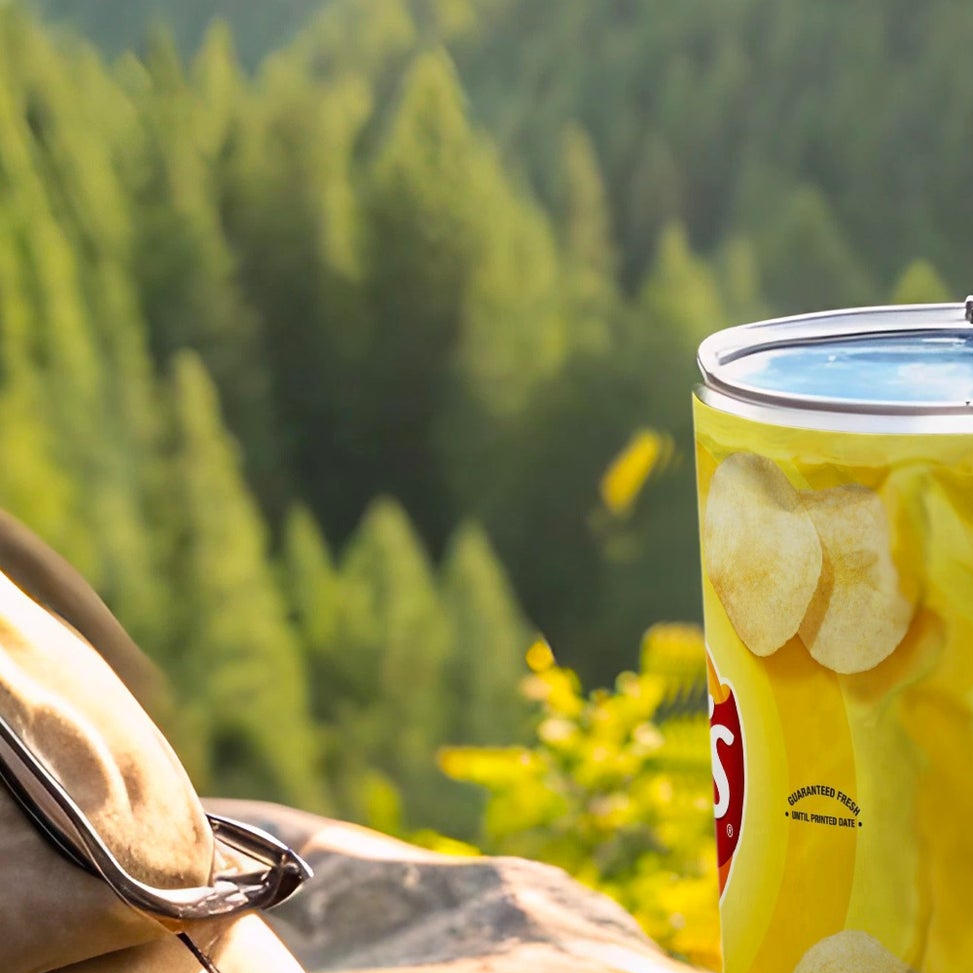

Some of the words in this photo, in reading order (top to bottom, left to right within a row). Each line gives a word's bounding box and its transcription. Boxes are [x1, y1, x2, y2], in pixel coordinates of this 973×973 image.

[787, 785, 836, 806] GUARANTEED
[837, 791, 861, 816] FRESH
[792, 811, 809, 822] UNTIL
[811, 814, 837, 826] PRINTED
[839, 817, 856, 828] DATE
